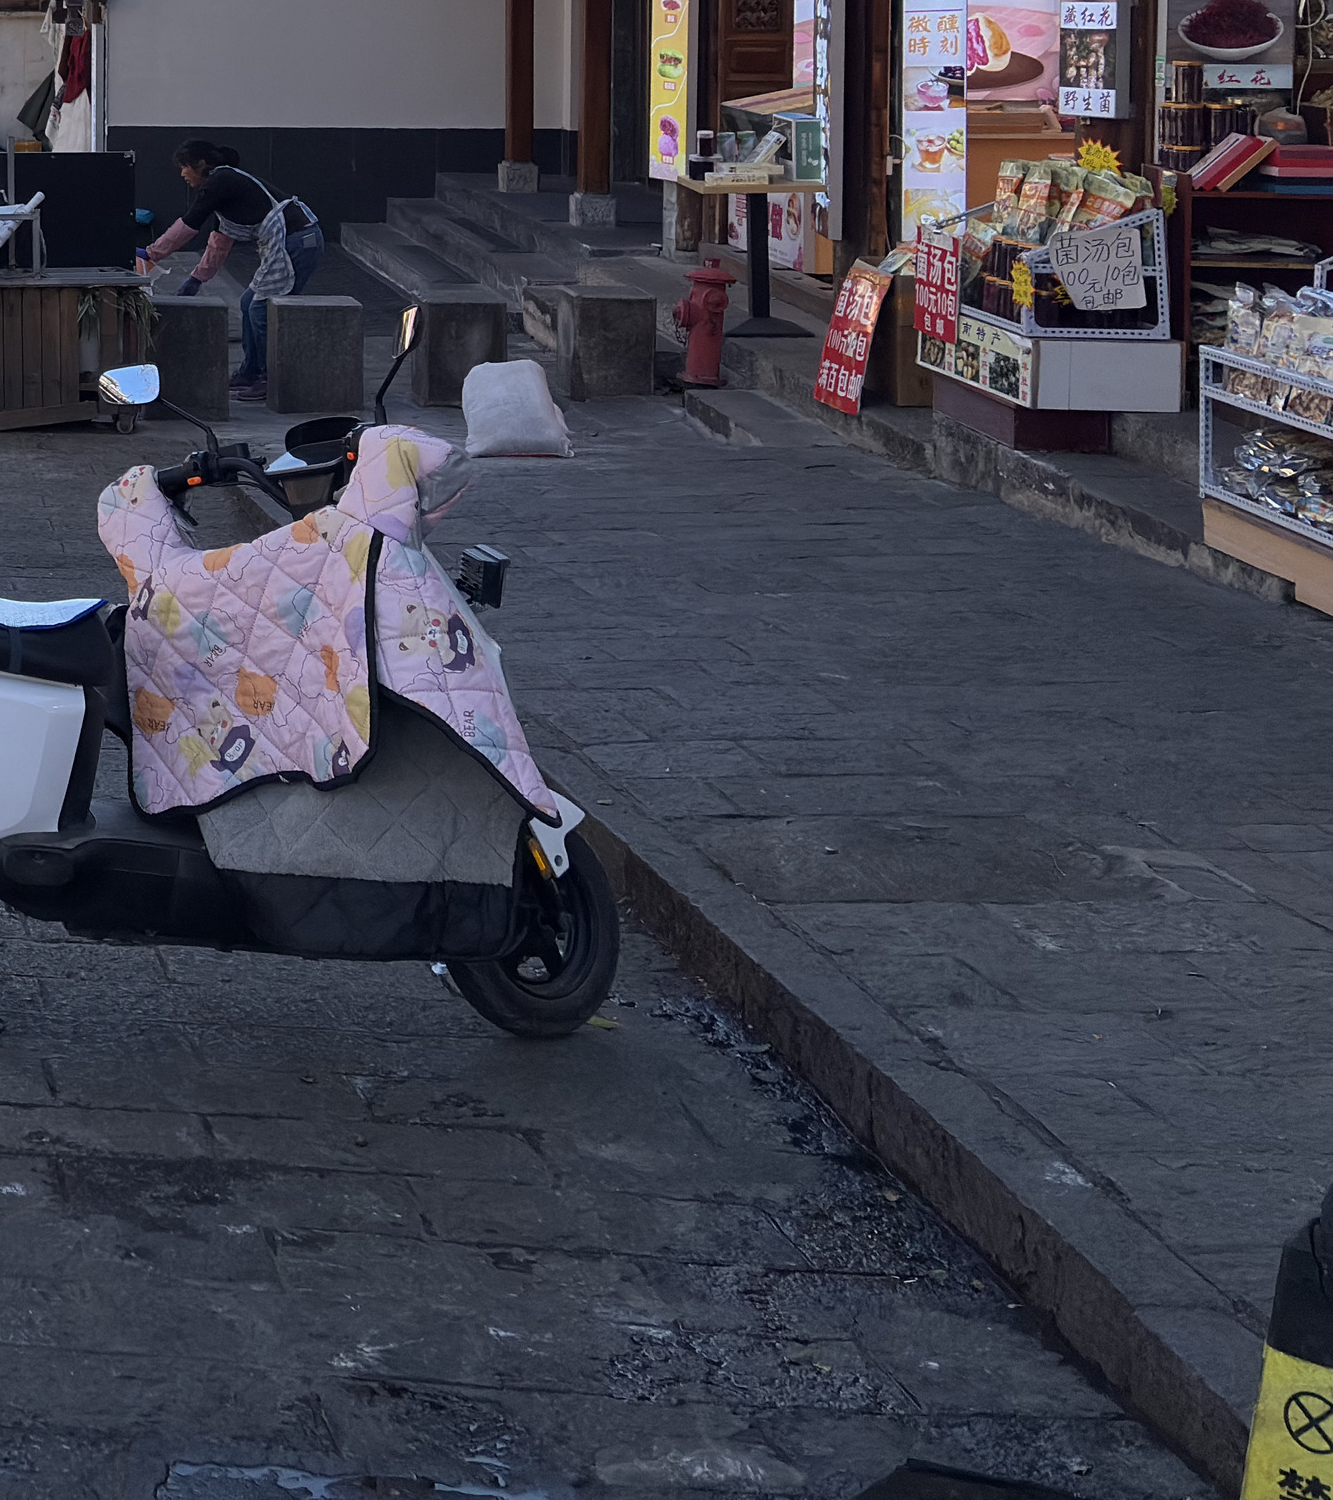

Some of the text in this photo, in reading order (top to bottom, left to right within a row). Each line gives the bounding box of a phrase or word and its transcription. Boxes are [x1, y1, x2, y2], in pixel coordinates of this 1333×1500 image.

[1063, 5, 1115, 28] 藏红花
[1204, 69, 1271, 88] 红花
[1063, 90, 1111, 114] 野生菌
[1055, 232, 1136, 267] 菌汤包
[915, 242, 958, 292] 菌汤包
[834, 279, 876, 325] 菌汤包
[915, 283, 957, 321] 100元10包
[924, 313, 945, 336] 包邮
[205, 644, 224, 668] BEAR
[463, 709, 475, 738] BEAR
